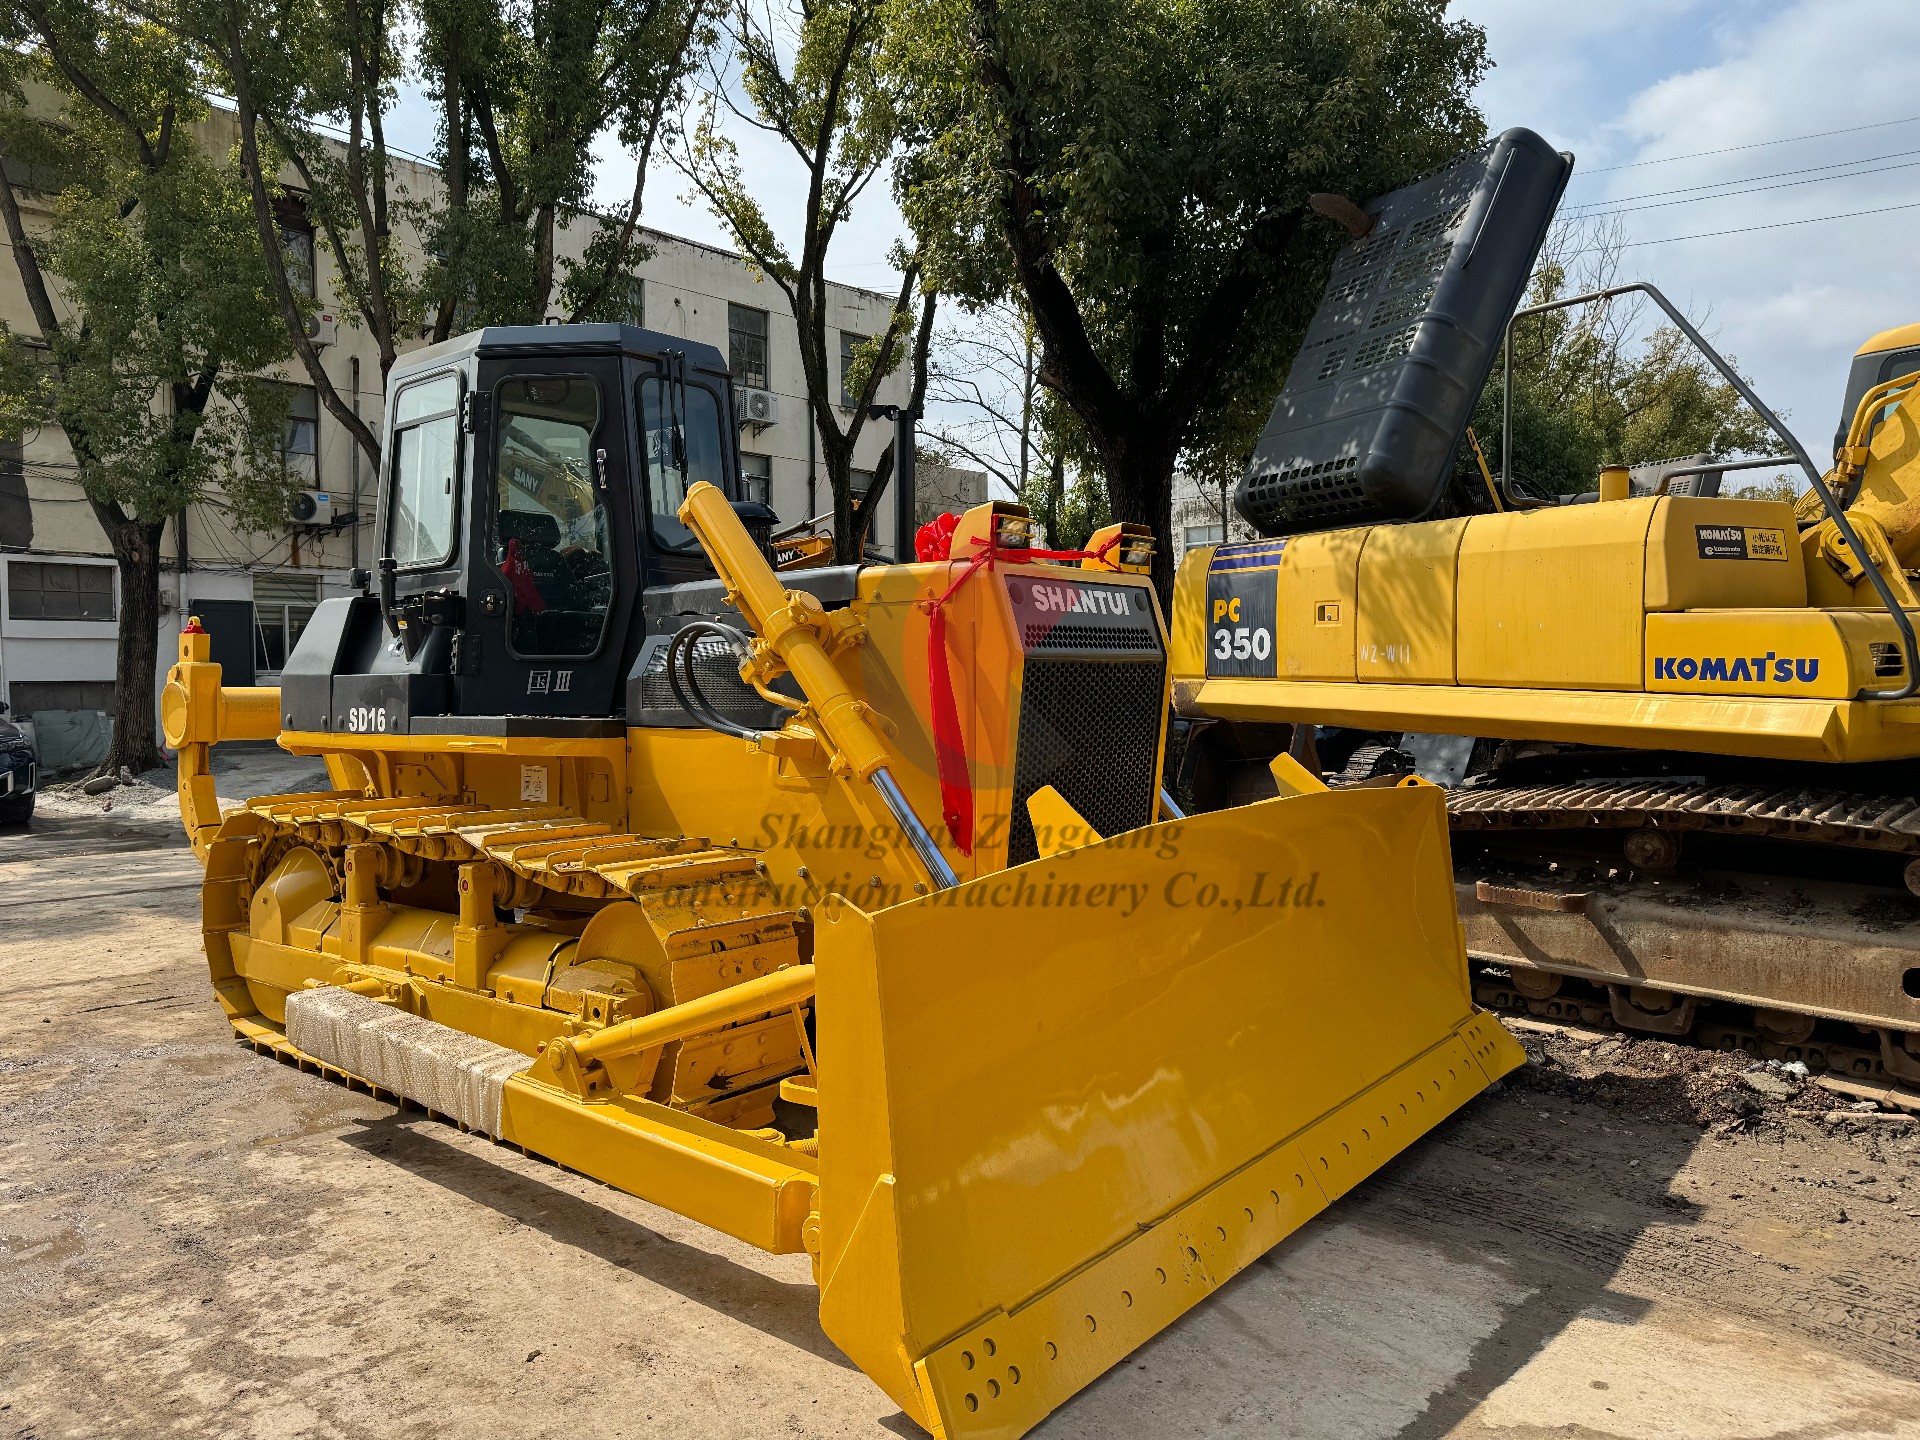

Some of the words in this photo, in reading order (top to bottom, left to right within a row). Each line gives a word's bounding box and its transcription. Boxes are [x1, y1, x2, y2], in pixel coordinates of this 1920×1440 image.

[513, 467, 538, 492] SANY
[1699, 528, 1742, 541] KOMATSU
[777, 550, 794, 562] ANY
[1031, 584, 1131, 616] SHANTUI
[1213, 597, 1241, 624] PC
[1214, 627, 1271, 661] 350
[1654, 651, 1819, 683] KOMATSU
[349, 707, 386, 732] SD16
